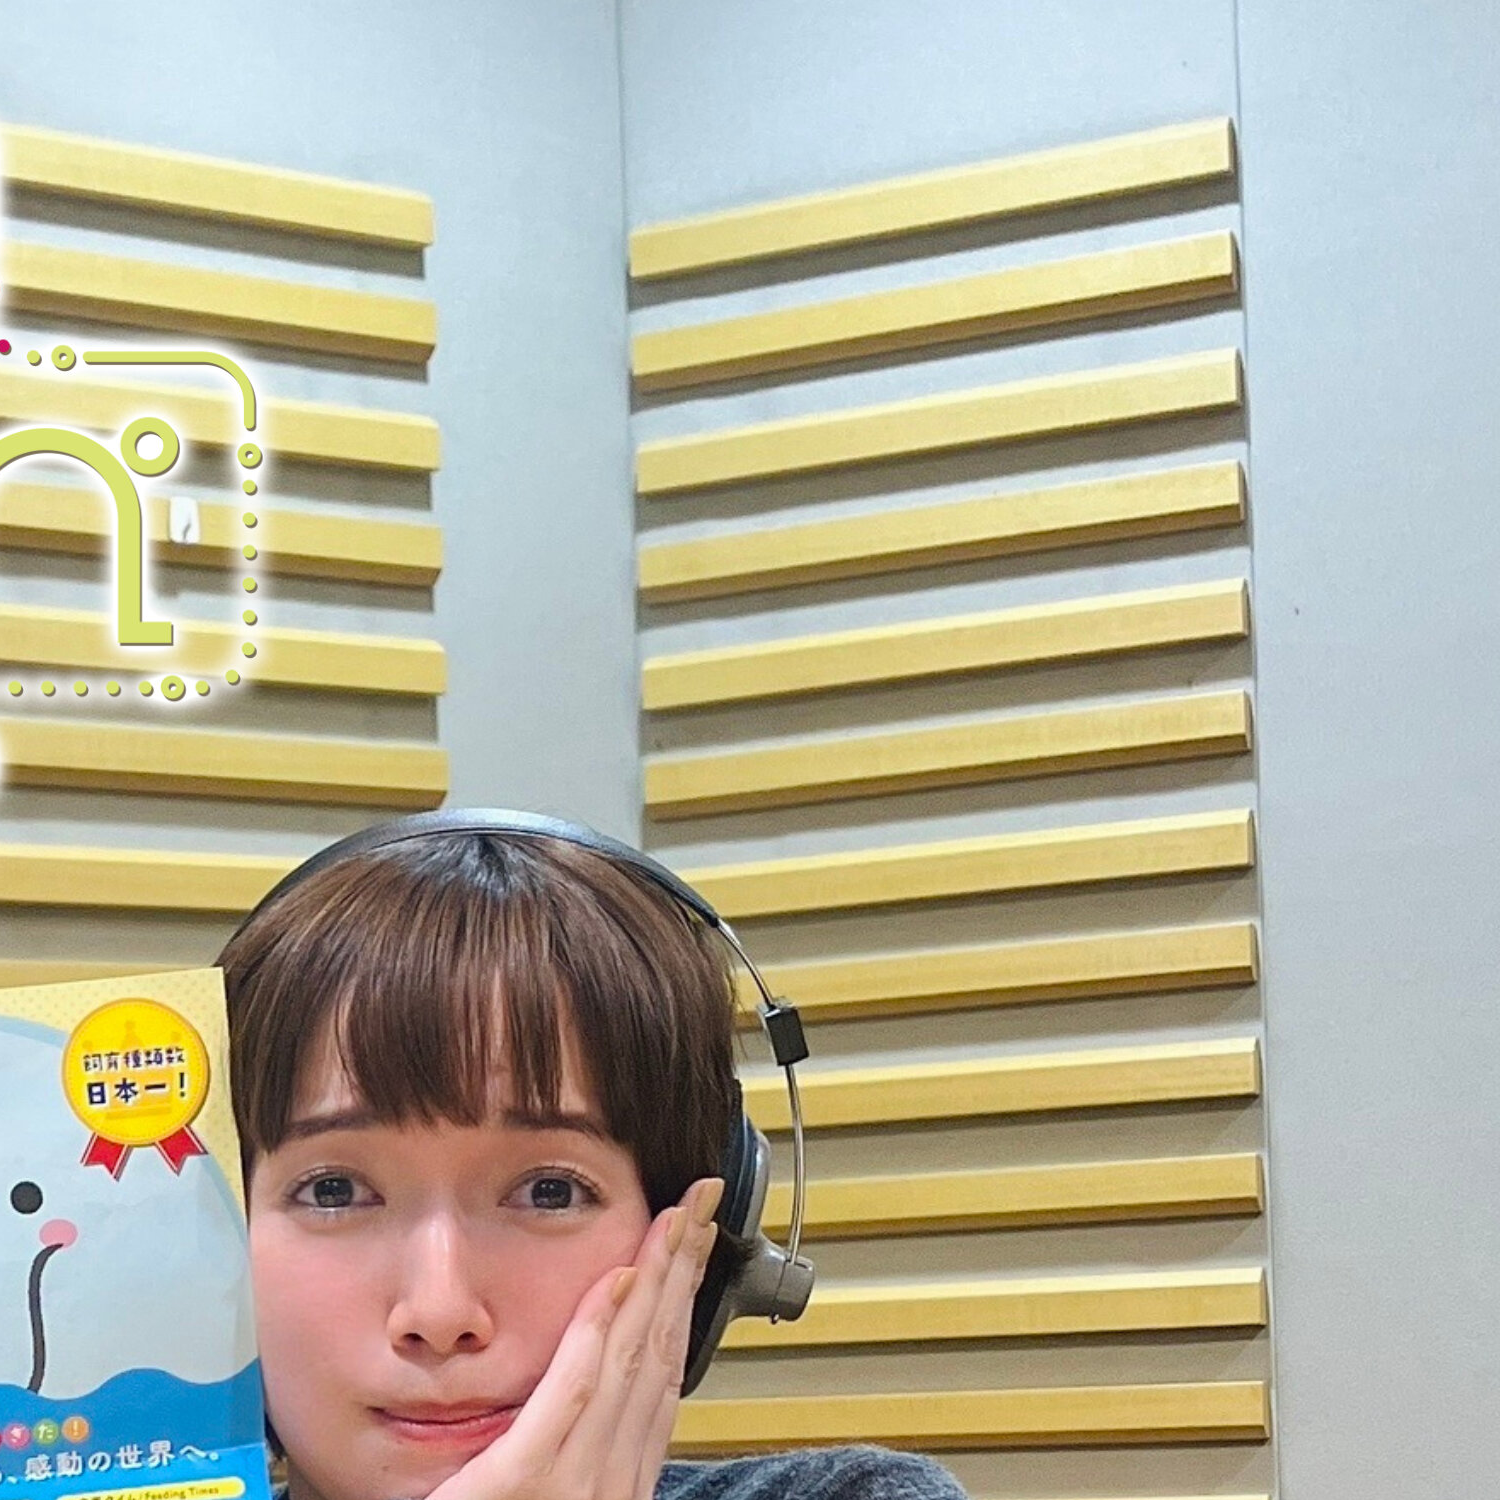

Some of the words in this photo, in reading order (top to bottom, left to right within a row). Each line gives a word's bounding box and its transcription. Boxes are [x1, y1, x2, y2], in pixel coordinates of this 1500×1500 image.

[82, 1047, 186, 1073] 飼育種類数
[188, 1486, 219, 1497] Times
